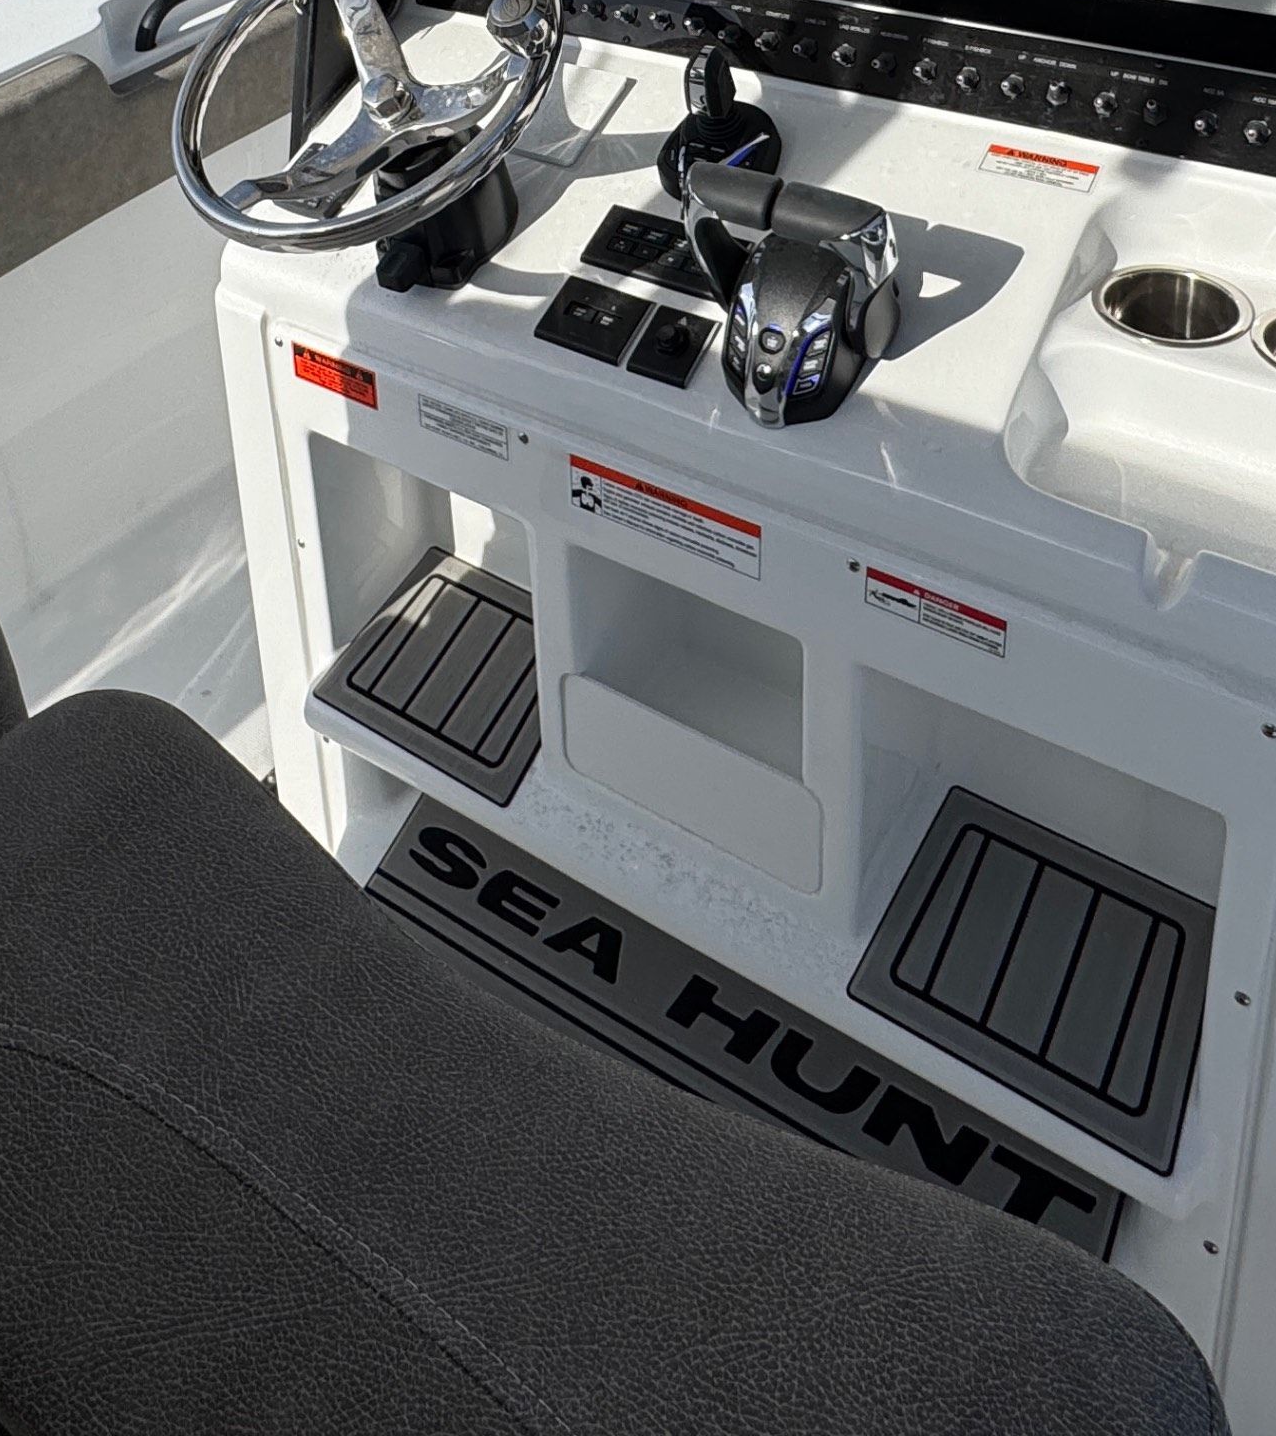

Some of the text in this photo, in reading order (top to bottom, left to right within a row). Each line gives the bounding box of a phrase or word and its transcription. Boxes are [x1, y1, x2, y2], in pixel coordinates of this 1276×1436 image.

[1018, 149, 1068, 168] WARNING
[643, 482, 689, 510] WARNING
[924, 591, 960, 612] DANGER
[407, 825, 624, 984] SEA
[665, 972, 1098, 1224] HUNT
